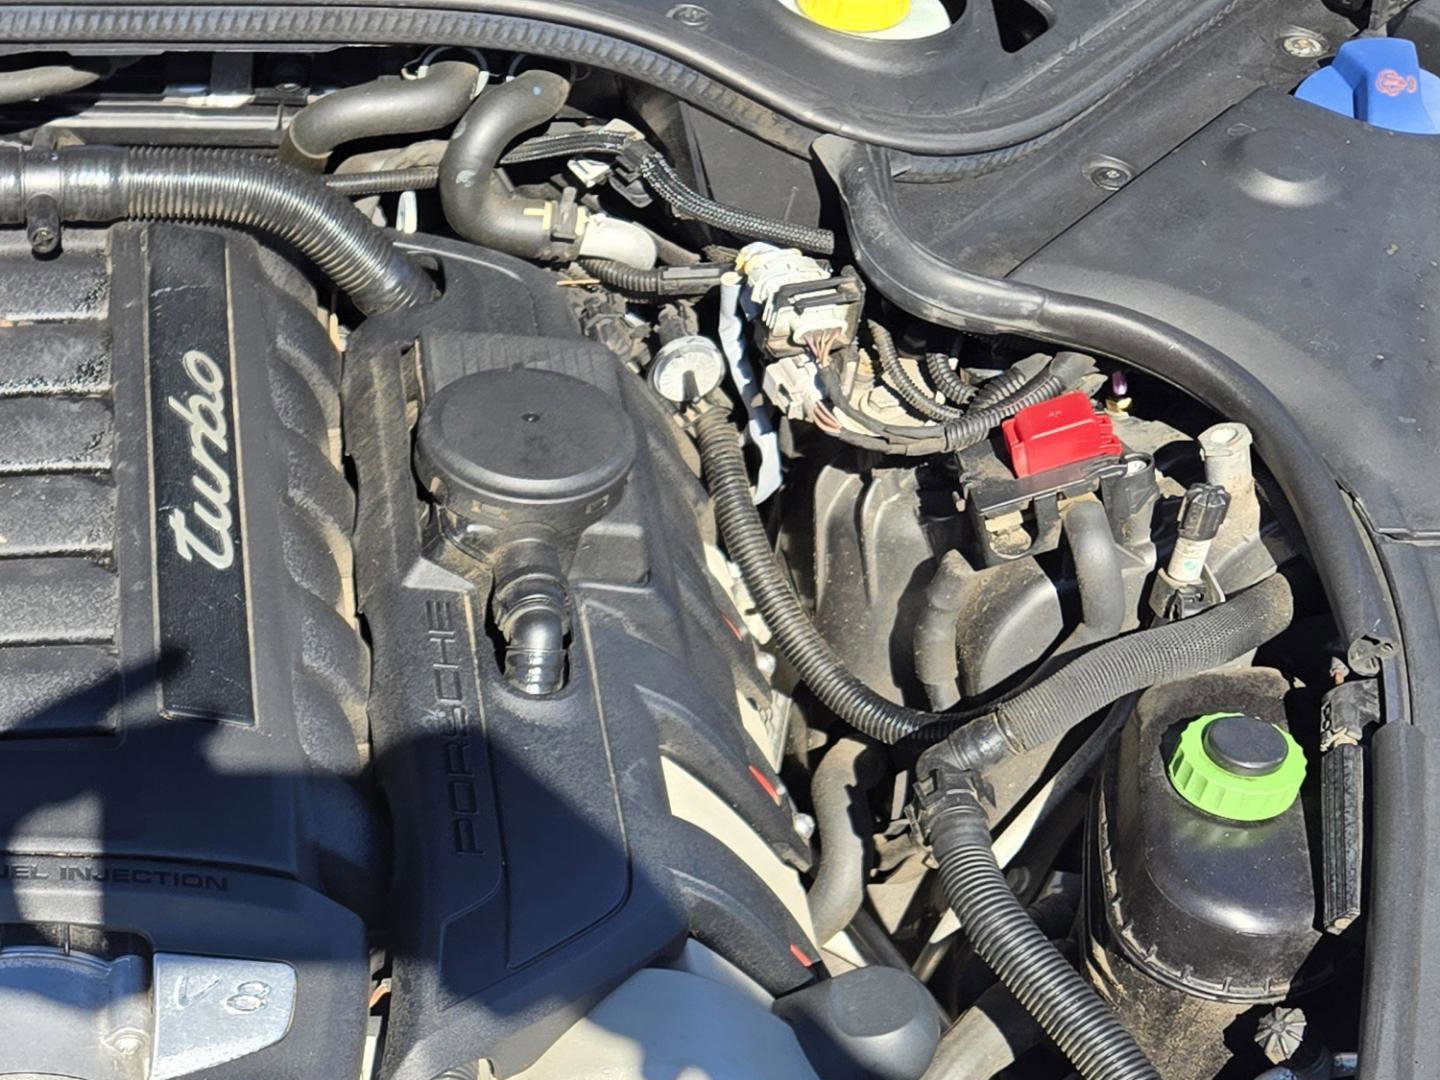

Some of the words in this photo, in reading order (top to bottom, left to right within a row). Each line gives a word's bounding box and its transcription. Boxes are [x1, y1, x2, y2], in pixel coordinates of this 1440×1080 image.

[168, 350, 235, 570] turbo
[425, 601, 485, 855] PORSCHE
[60, 866, 229, 892] INJECTION
